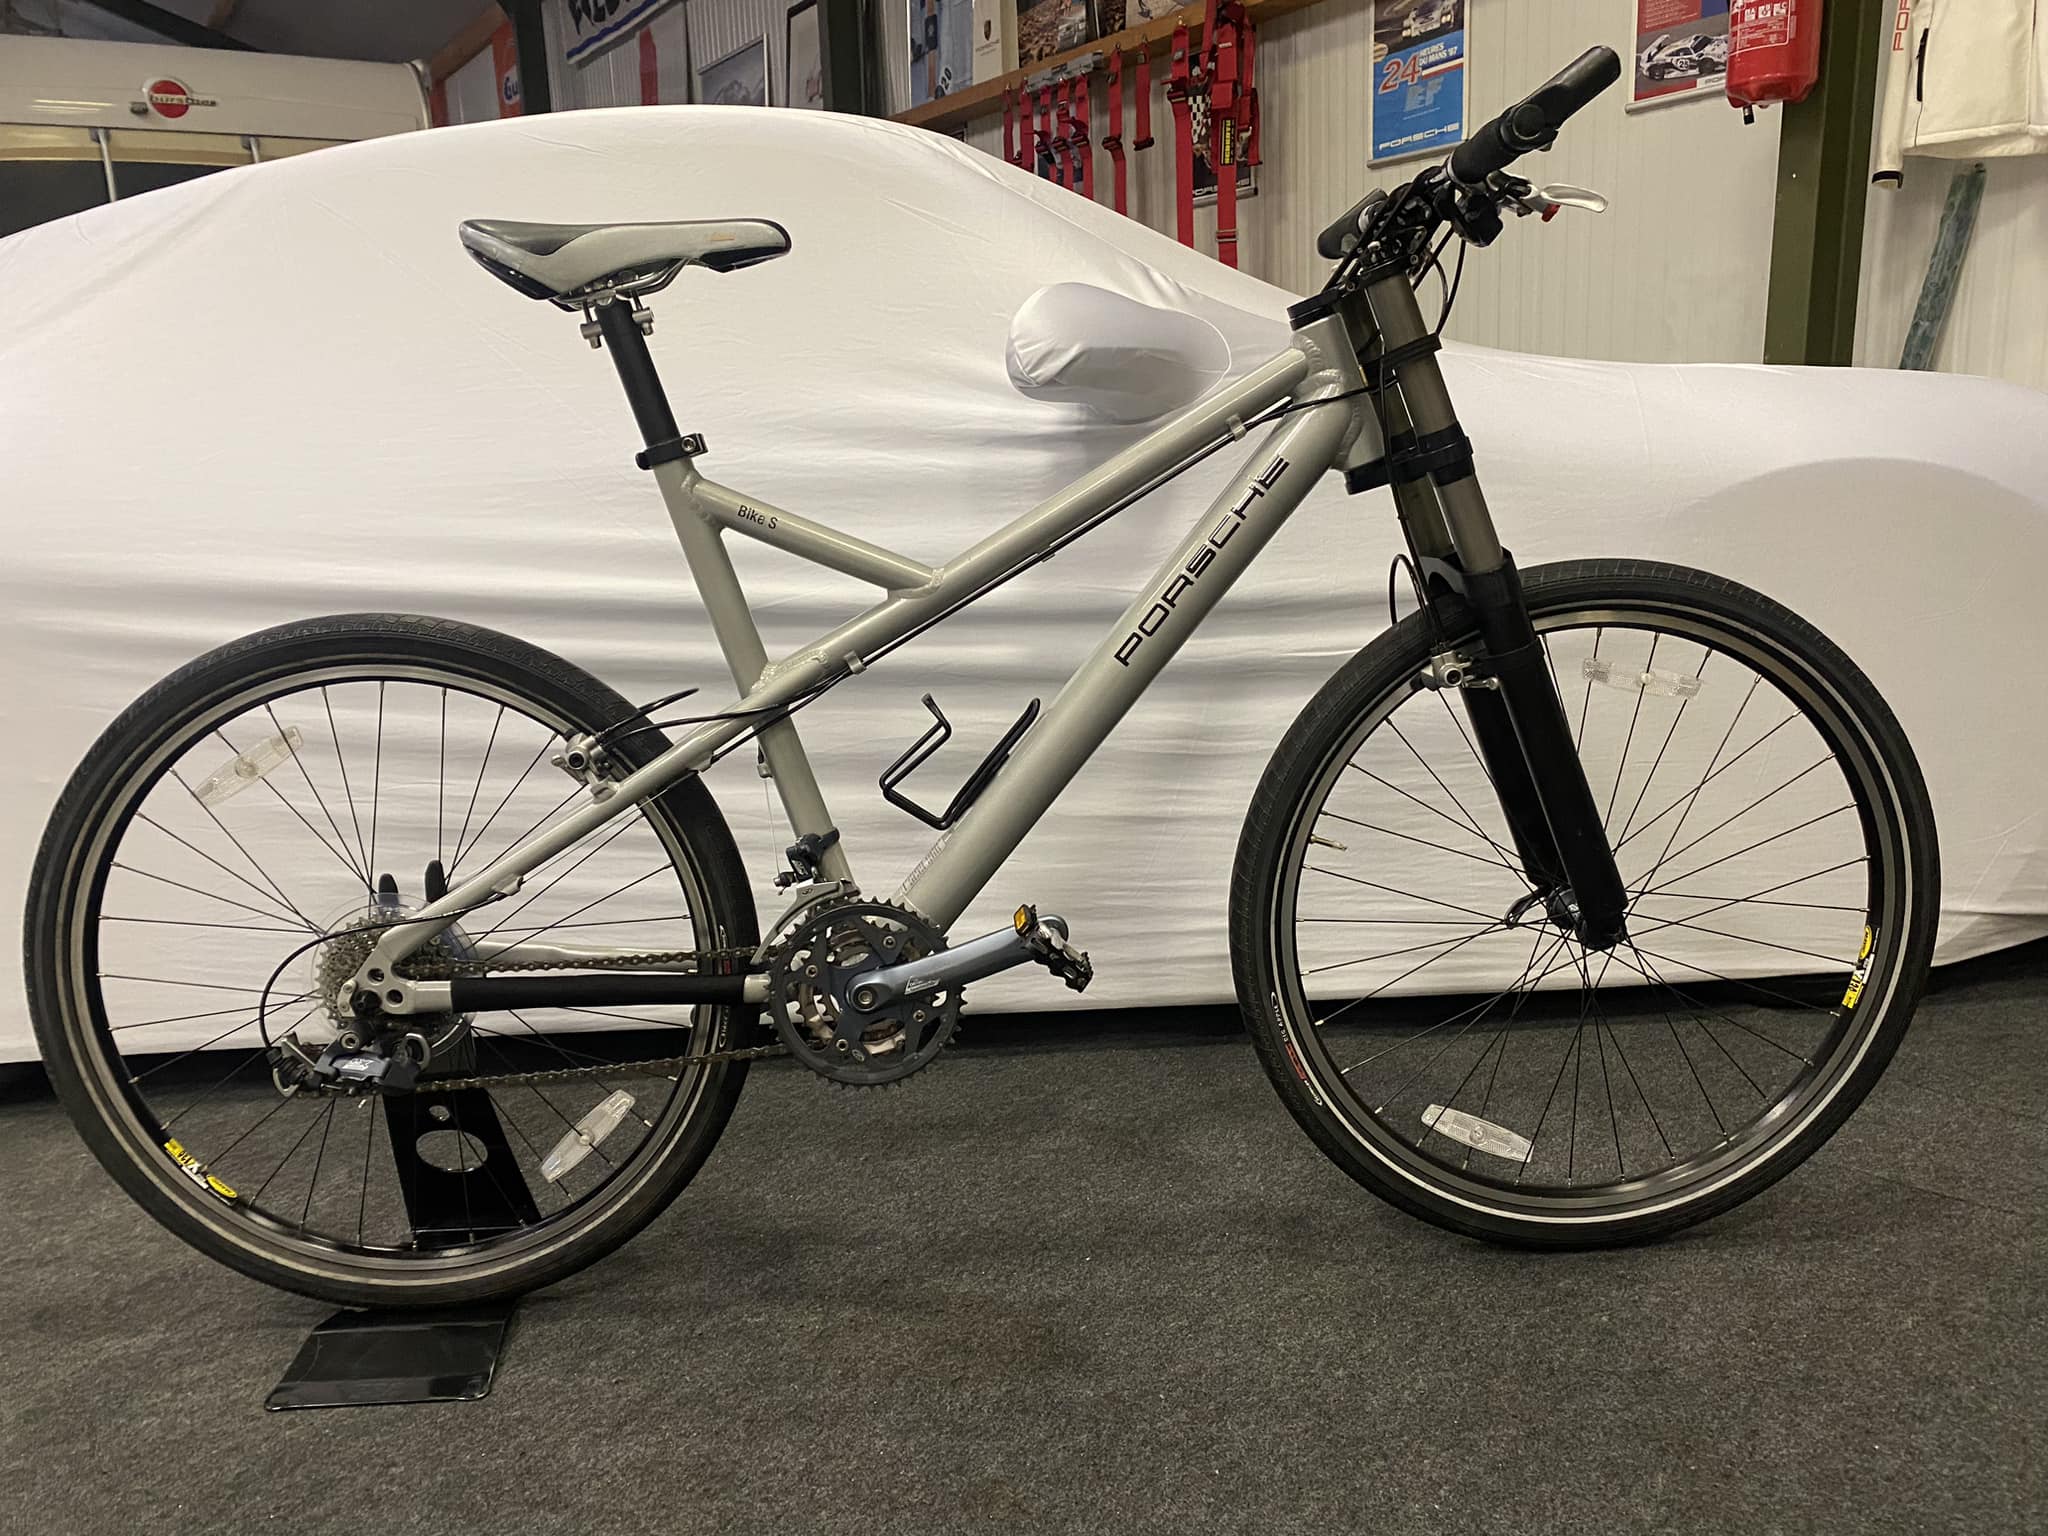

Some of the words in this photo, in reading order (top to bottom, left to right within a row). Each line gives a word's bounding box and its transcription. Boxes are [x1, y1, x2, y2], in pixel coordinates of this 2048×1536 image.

[1379, 53, 1421, 94] 24
[1379, 122, 1460, 151] PORSCHE
[737, 505, 765, 525] Bike
[768, 516, 779, 529] S
[1114, 457, 1290, 667] PORSCHE
